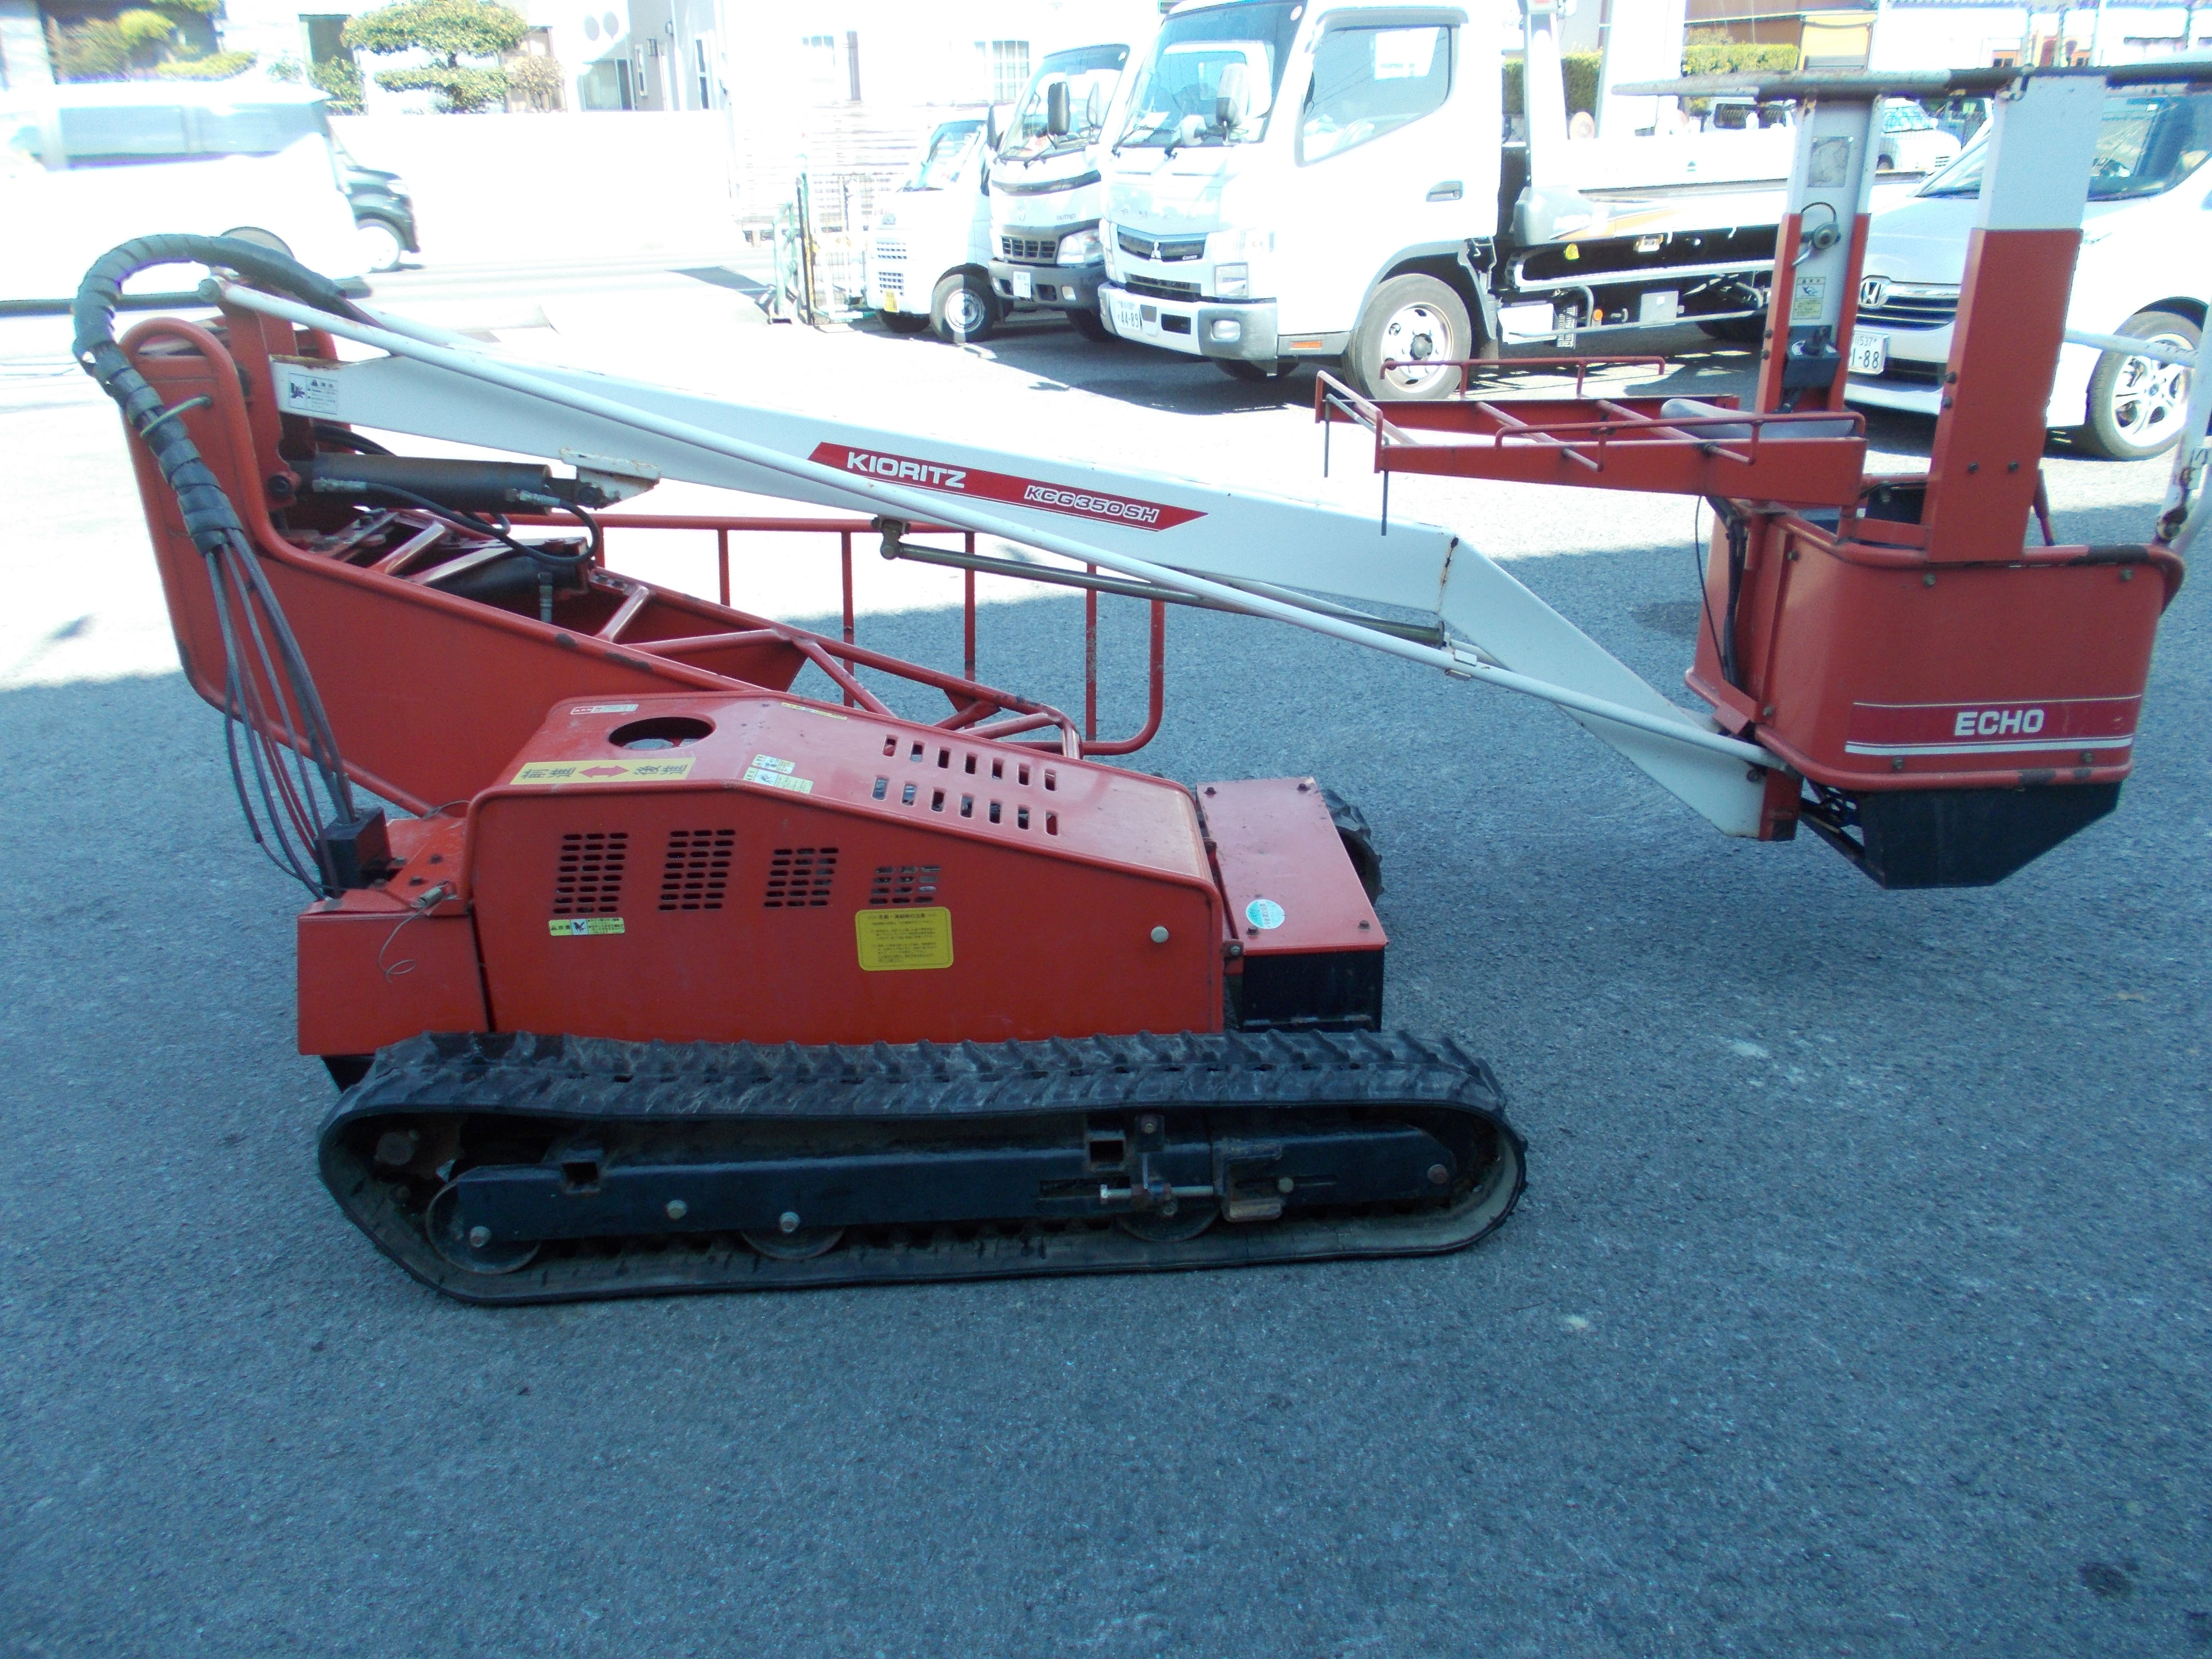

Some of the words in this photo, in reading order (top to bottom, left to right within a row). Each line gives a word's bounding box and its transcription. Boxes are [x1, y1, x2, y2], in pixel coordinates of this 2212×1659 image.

[847, 451, 966, 489] KIORITZ
[1024, 484, 1160, 523] KCG350SH
[1954, 709, 2045, 737] ECHO
[521, 767, 577, 779] 前進
[633, 764, 688, 776] 後進
